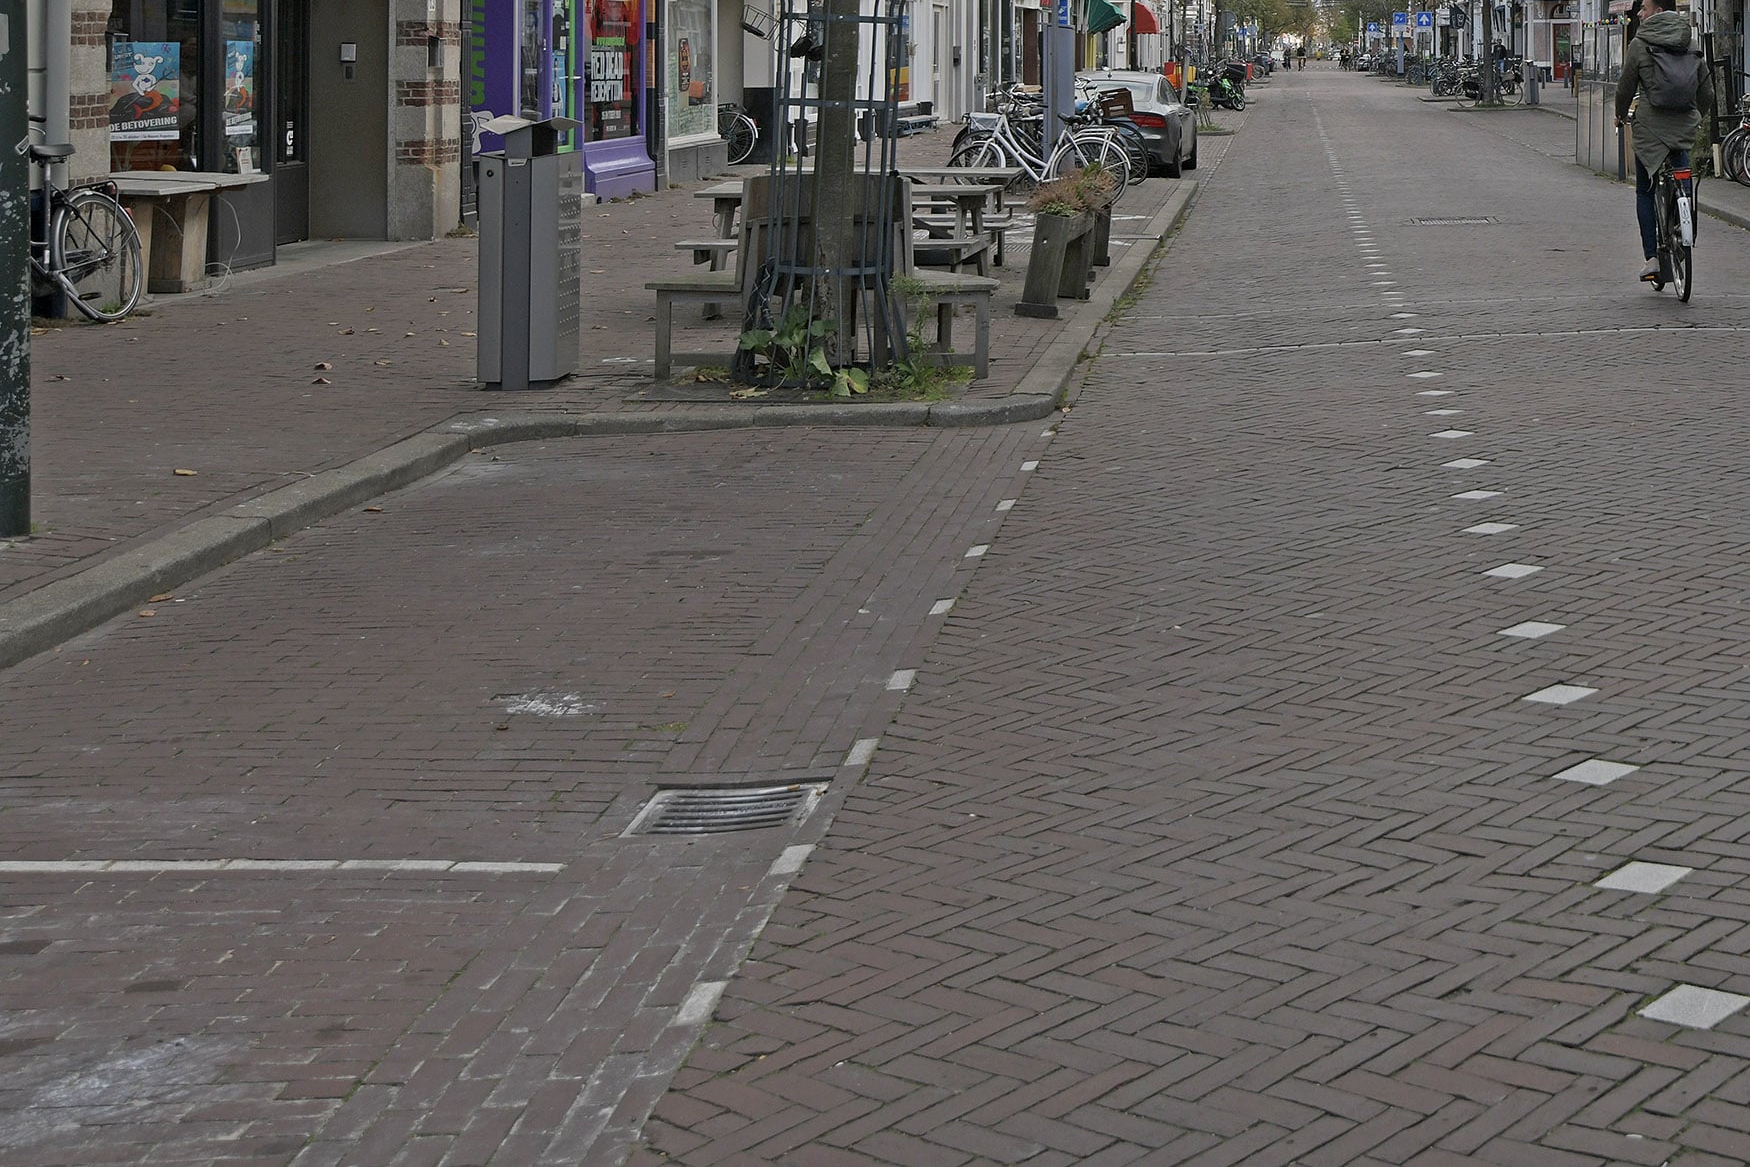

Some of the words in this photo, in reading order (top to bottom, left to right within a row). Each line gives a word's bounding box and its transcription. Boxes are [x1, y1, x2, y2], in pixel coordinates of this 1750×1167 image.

[591, 51, 605, 80] RED
[605, 51, 624, 80] DEAD
[121, 116, 178, 131] BETOVERING
